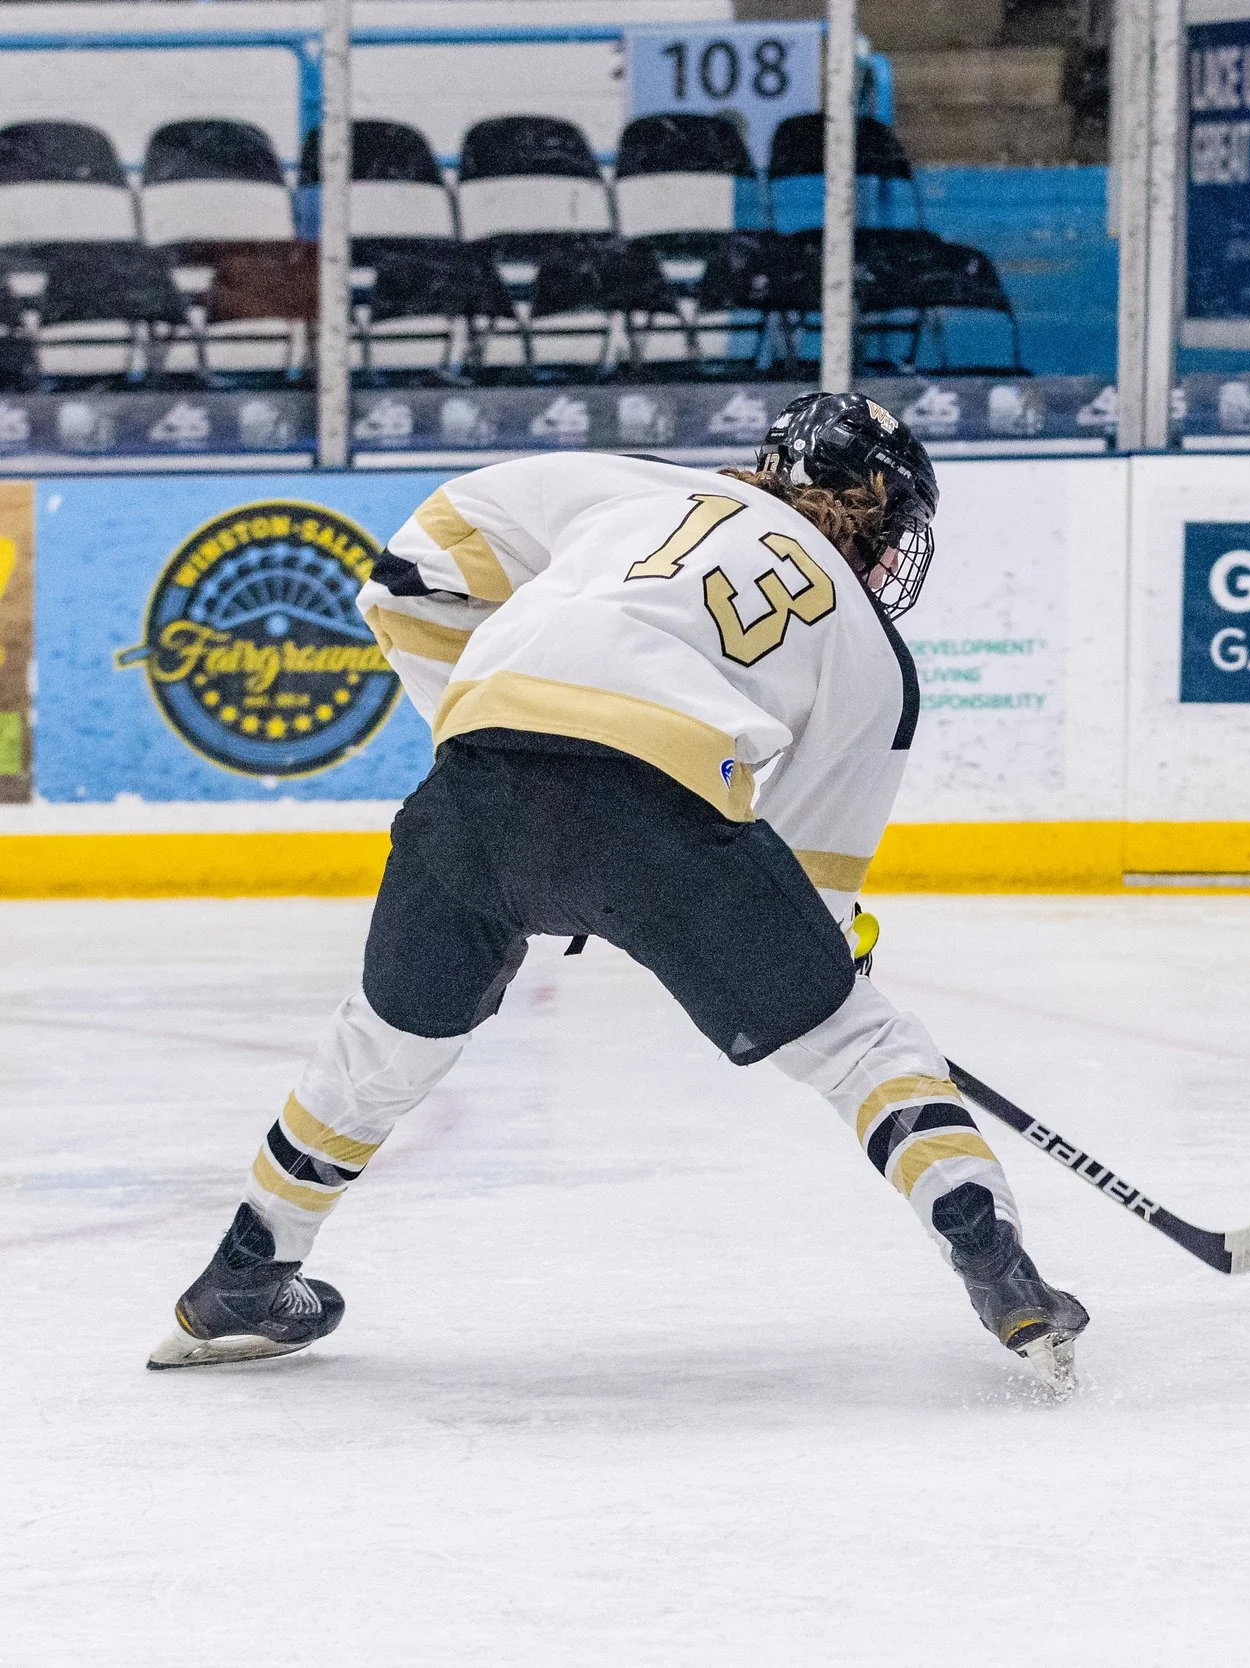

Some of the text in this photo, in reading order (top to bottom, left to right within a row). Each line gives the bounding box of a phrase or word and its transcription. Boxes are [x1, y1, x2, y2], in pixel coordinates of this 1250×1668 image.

[661, 40, 790, 98] 108
[1191, 121, 1250, 184] GREAT
[623, 494, 836, 668] 13
[151, 620, 398, 693] Fairground
[920, 692, 1046, 711] ESPONSIBILITY
